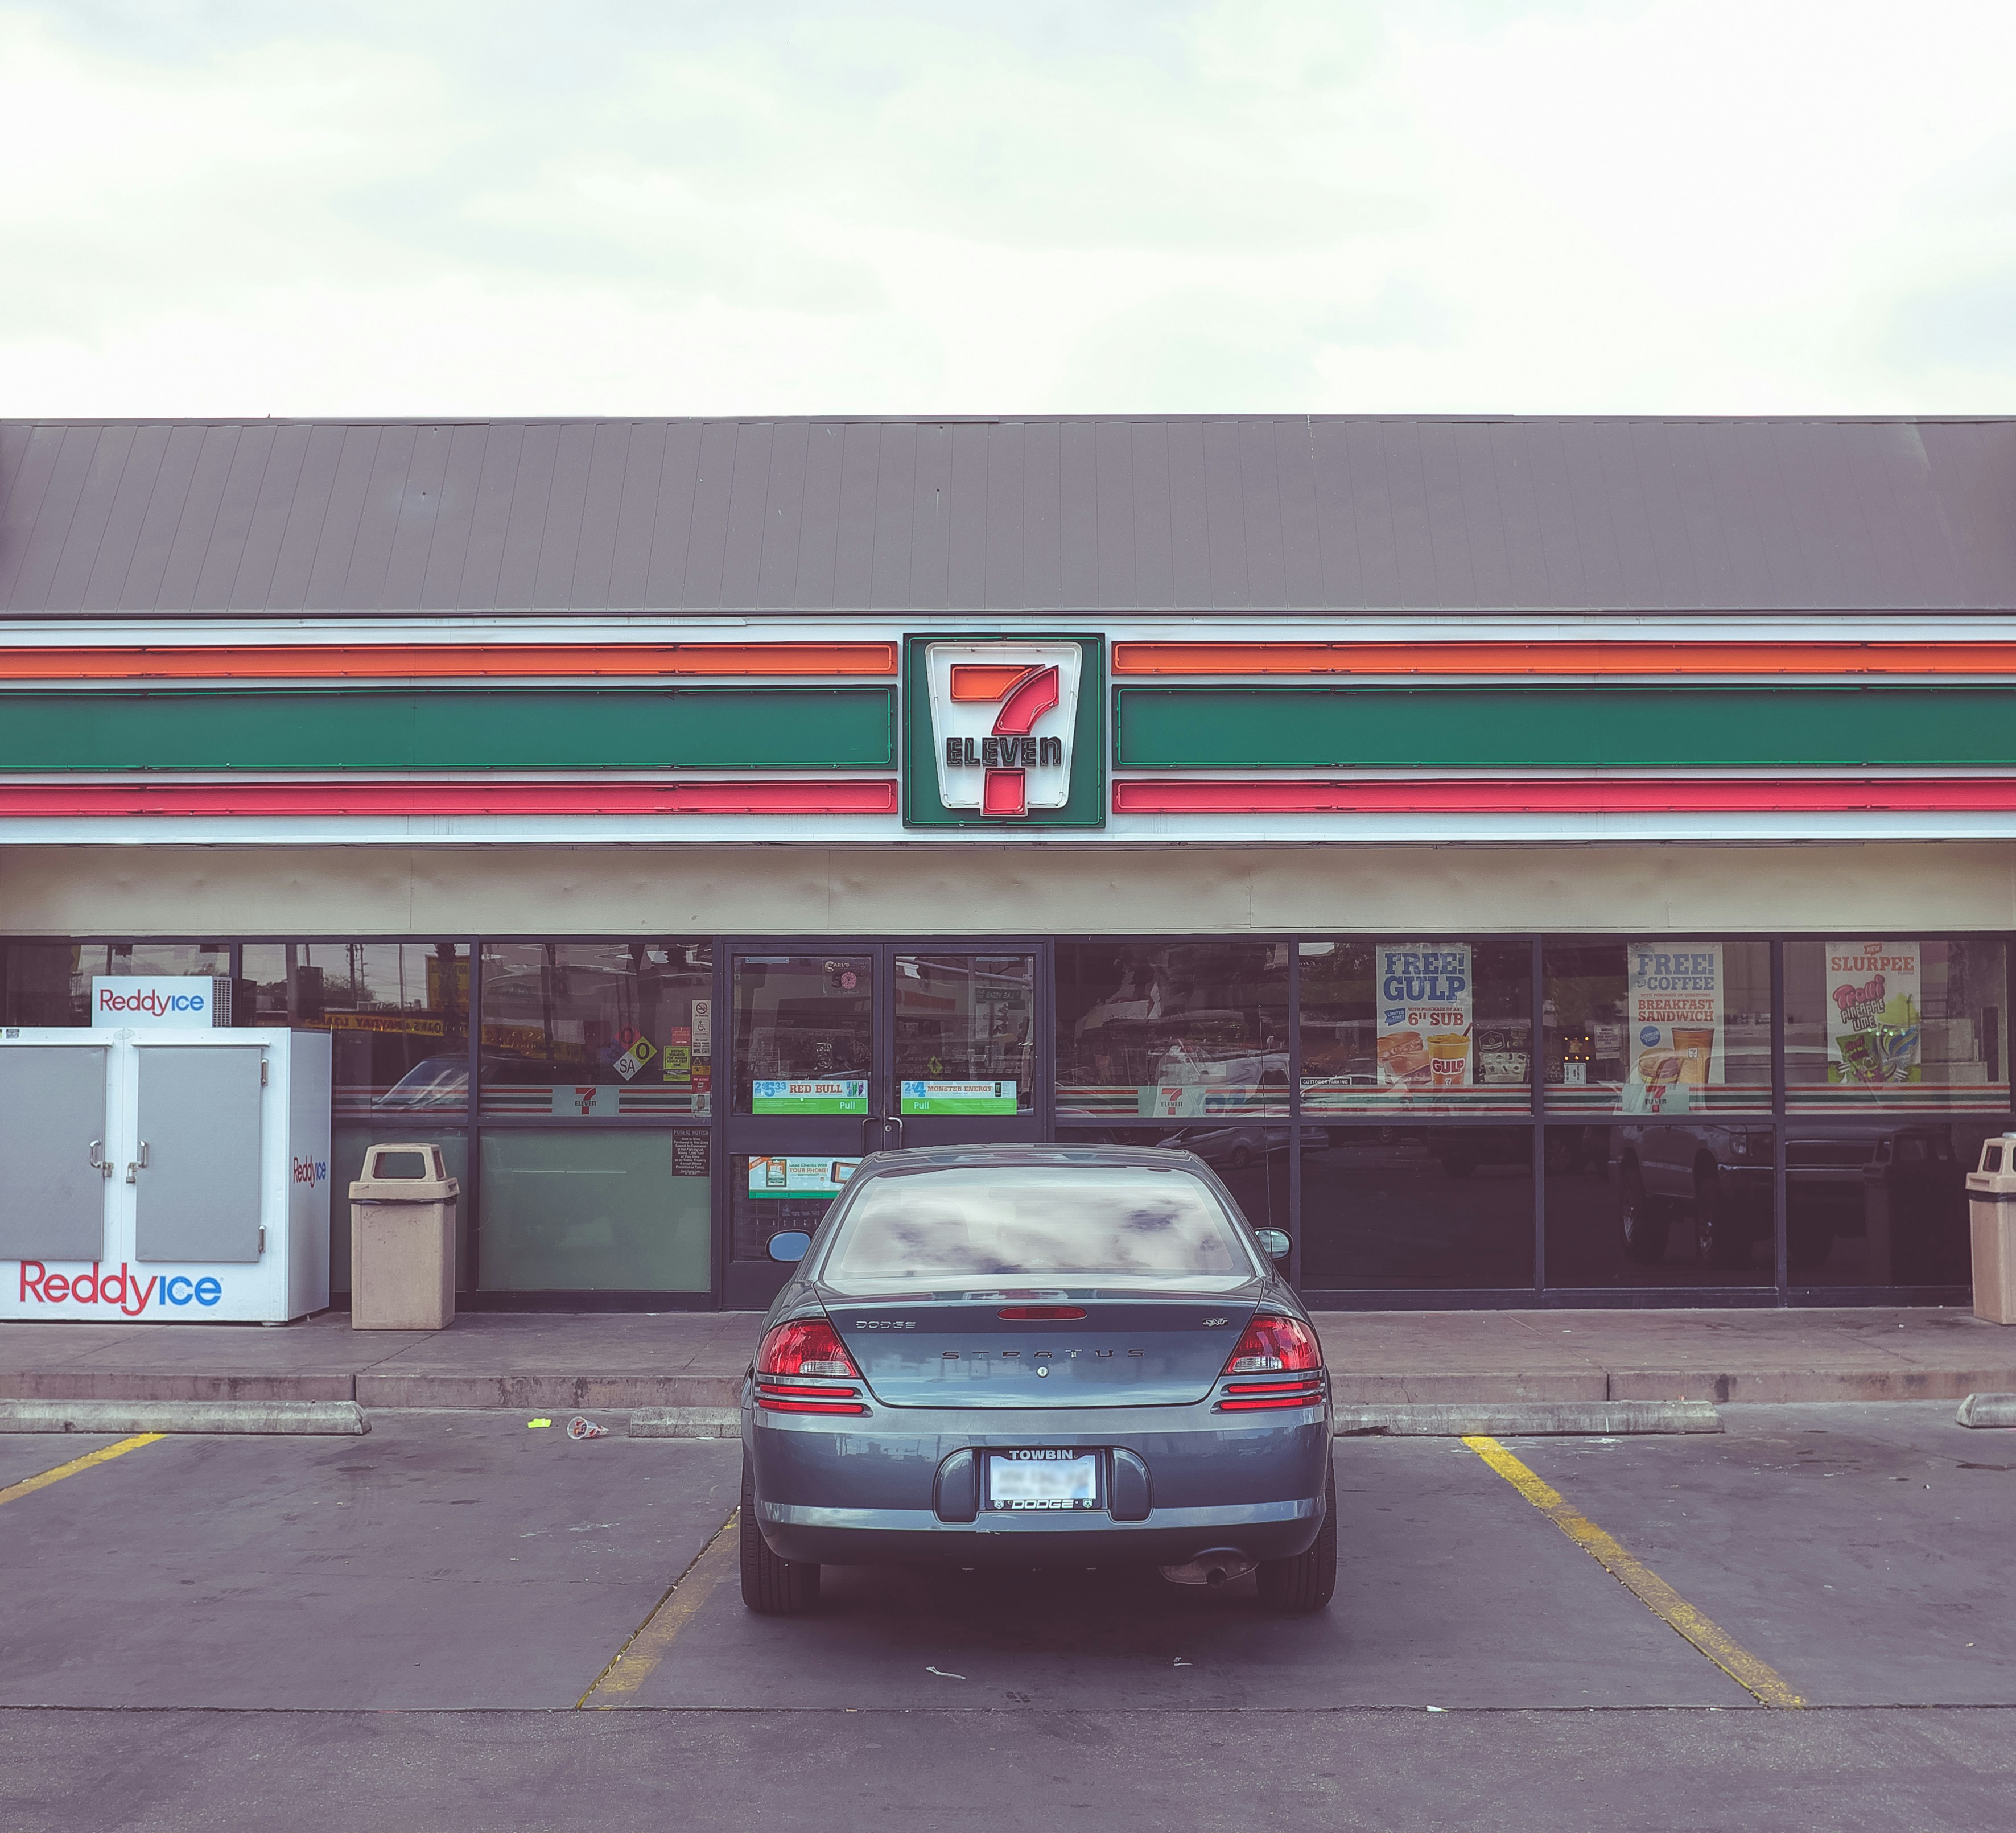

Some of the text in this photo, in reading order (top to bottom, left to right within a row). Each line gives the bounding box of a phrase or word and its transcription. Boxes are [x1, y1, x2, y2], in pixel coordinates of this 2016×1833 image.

[950, 664, 1059, 815] 7
[946, 736, 1062, 767] ELEVEn
[1384, 952, 1465, 975] FREE!
[1637, 954, 1714, 975] FREE!
[1831, 956, 1915, 971] SLURPEE
[1383, 975, 1466, 1003] GULP
[1647, 976, 1714, 990] COFFEE
[1832, 974, 1885, 1010] Trolli
[1638, 999, 1714, 1010] BREAKFAST
[1841, 998, 1885, 1023] PINEAPPLE
[1430, 1012, 1464, 1026] SUB
[1638, 1011, 1714, 1022] SANDWICH
[1853, 1016, 1876, 1031] LIME
[620, 1058, 636, 1073] SA
[1432, 1058, 1465, 1073] GULP
[789, 1084, 843, 1093] RED BULL
[575, 1087, 596, 1114] 7
[1162, 1088, 1182, 1115] 7
[855, 1320, 917, 1329] DODGE
[942, 1348, 1145, 1360] STRATUS
[1009, 1449, 1073, 1460] TOWBIN
[1011, 1499, 1074, 1509] DODGE
